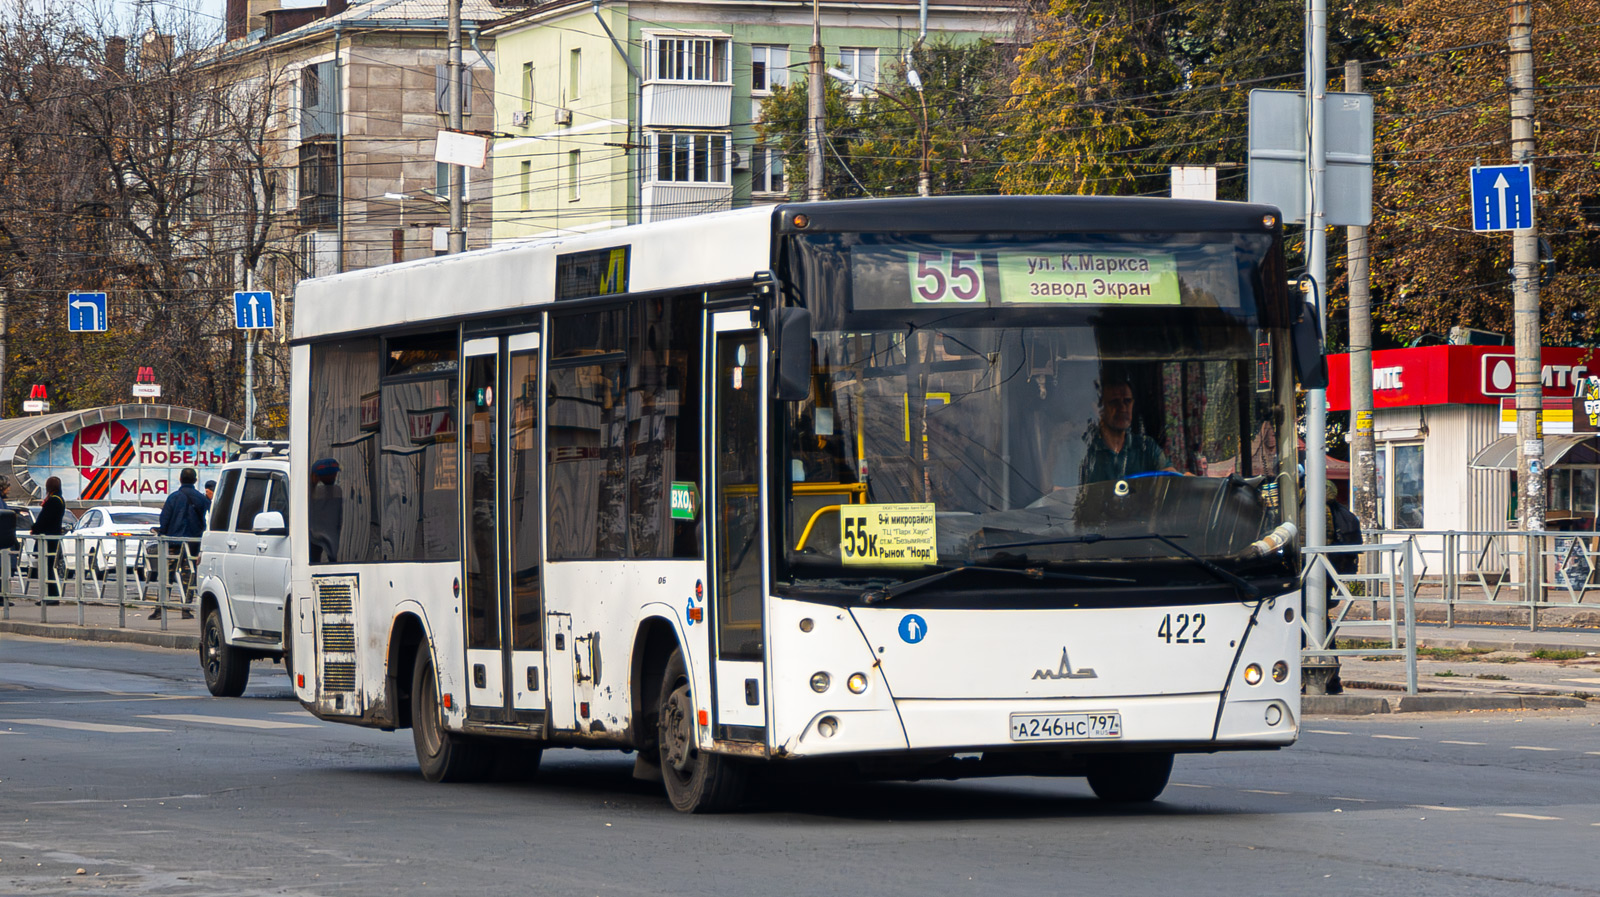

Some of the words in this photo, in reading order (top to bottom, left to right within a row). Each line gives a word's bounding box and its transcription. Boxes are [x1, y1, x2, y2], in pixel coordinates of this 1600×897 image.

[1026, 255, 1056, 275] ул.
[1061, 253, 1149, 273] К.Маркса
[916, 251, 982, 301] 55
[1030, 280, 1087, 298] завод
[1092, 278, 1152, 299] Экран
[136, 366, 155, 382] М
[1373, 366, 1403, 390] МТС
[30, 384, 47, 399] М
[140, 432, 196, 448] ДЕНЬ
[140, 450, 226, 466] ПОБЕДЫ
[120, 479, 168, 494] МАЯ
[672, 490, 696, 513] ВХОД
[878, 514, 889, 525] 9-й
[891, 512, 933, 527] микрорайон
[879, 546, 905, 559] Рынок
[907, 546, 934, 561] "Норд"
[1157, 613, 1206, 644] 422
[1018, 718, 1086, 737] А246НС
[1090, 716, 1115, 730] 797
